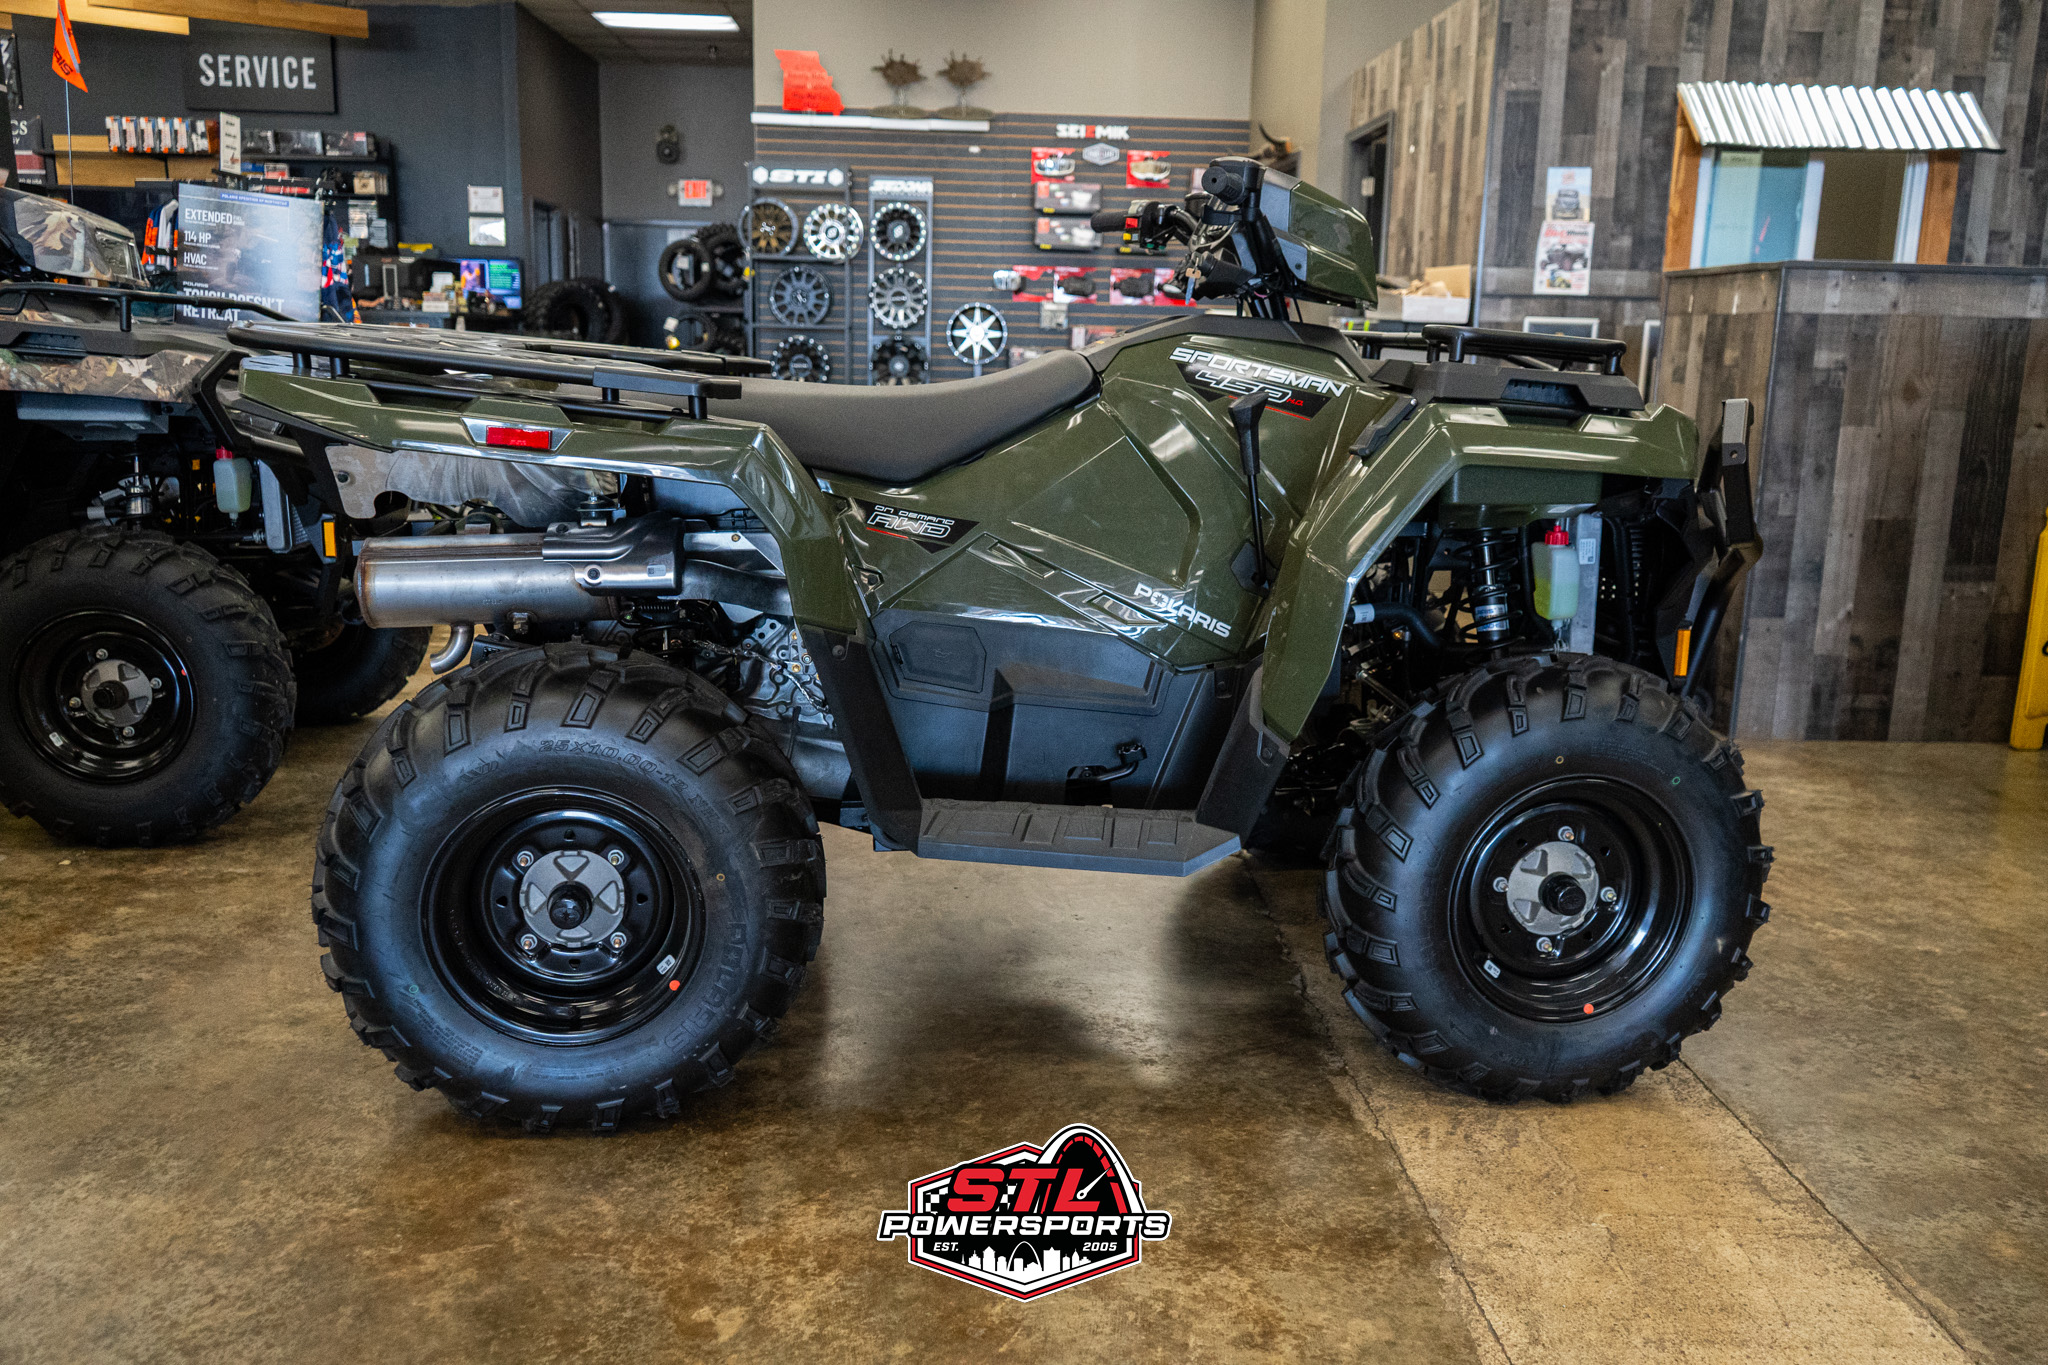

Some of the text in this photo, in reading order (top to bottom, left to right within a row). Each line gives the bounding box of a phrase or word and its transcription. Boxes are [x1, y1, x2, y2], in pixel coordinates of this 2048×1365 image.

[198, 53, 317, 89] SERVICE
[184, 208, 233, 225] EXTENDED
[183, 230, 211, 244] 114 HP
[183, 252, 207, 266] HVAC
[183, 281, 208, 289] POLARIS
[183, 304, 241, 322] RETRAT
[1169, 346, 1347, 398] SPORTSMAN
[1195, 369, 1292, 404] 450
[866, 511, 952, 539] AWD
[874, 504, 955, 526] ON DEMAND
[1133, 581, 1232, 638] POLARIS
